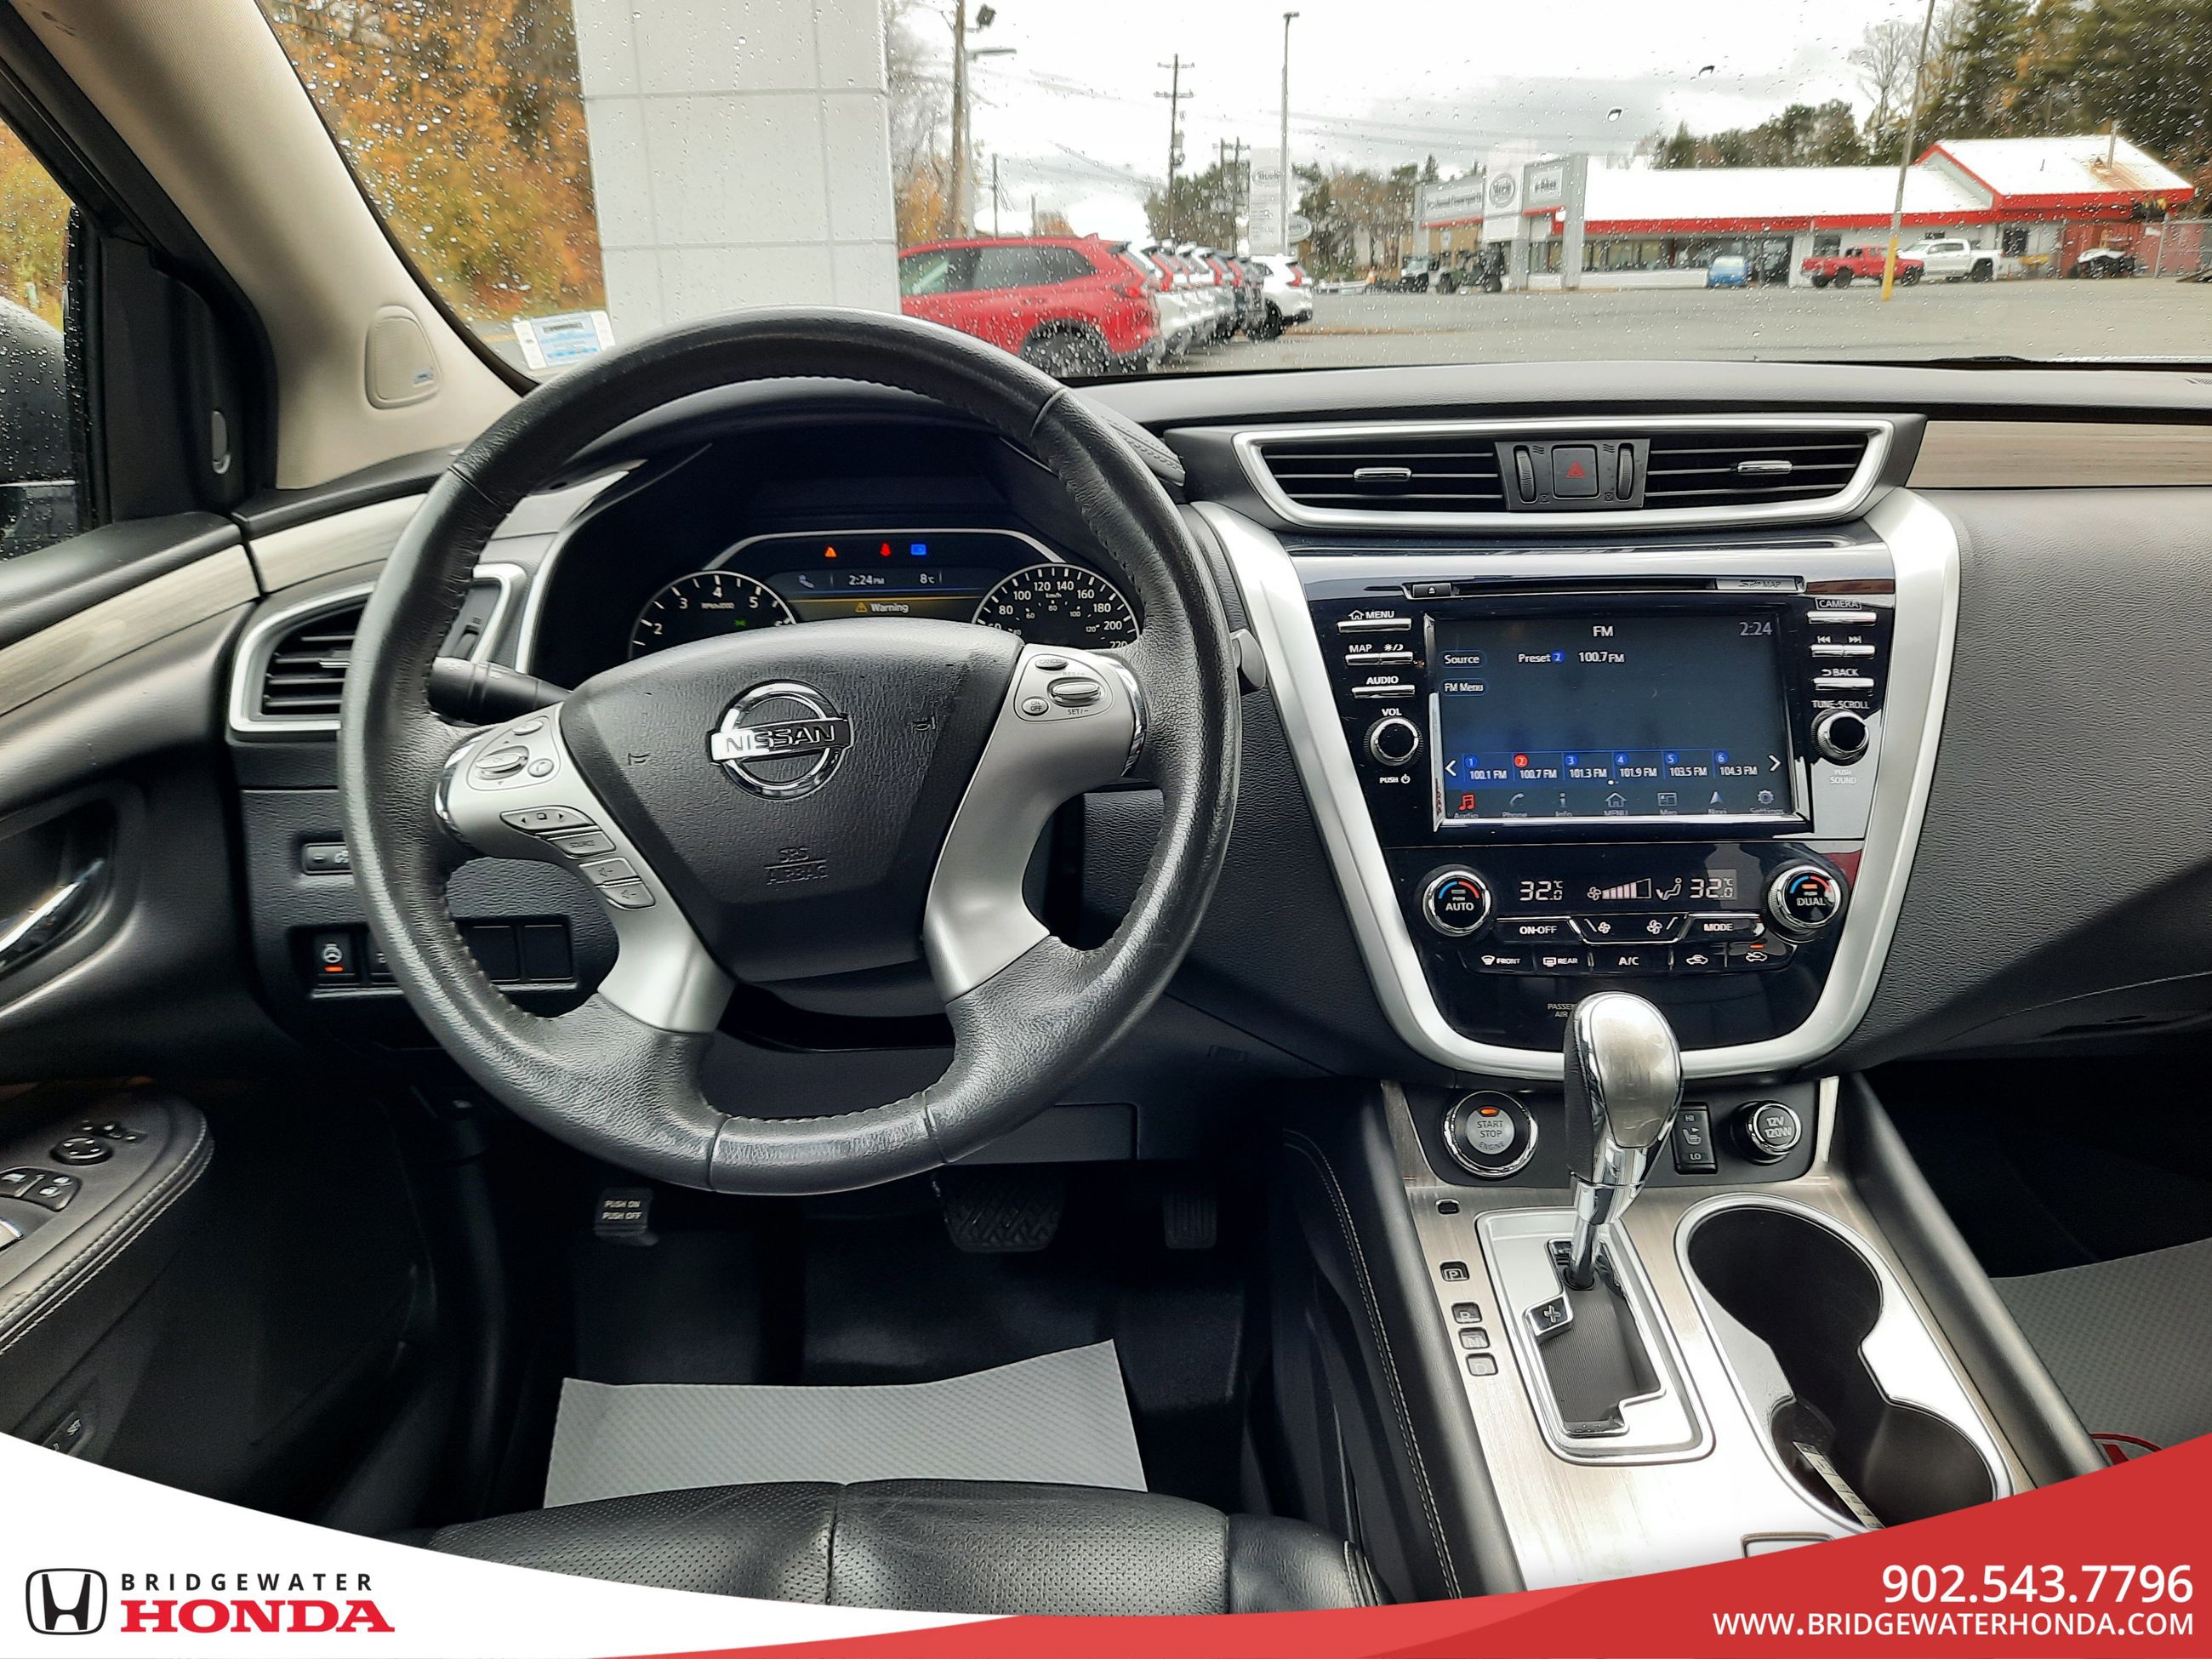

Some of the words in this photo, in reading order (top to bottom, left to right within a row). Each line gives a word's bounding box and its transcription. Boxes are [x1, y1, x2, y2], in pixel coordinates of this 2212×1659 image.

[1034, 582, 1051, 591] 120
[1057, 581, 1075, 591] 140
[712, 586, 722, 598] 4
[1013, 590, 1031, 601] 100
[1077, 590, 1094, 599] 160
[679, 598, 688, 609] 3
[749, 596, 758, 608] 5
[1818, 599, 1859, 608] CAMERA
[870, 603, 909, 613] Warning
[999, 605, 1013, 615] 80
[1093, 603, 1111, 613] 180
[1365, 611, 1395, 619] MENU
[652, 623, 663, 635] 2
[1103, 620, 1122, 630] 200
[1739, 622, 1773, 636] 2:24
[1593, 625, 1614, 637] FM
[1348, 644, 1372, 653] MAP
[1444, 655, 1480, 664] Source
[1518, 653, 1552, 663] Preset
[1833, 669, 1859, 677] BACK
[1366, 676, 1400, 685] AUDIO
[1444, 683, 1458, 693] FM
[1459, 682, 1484, 693] Menu
[1382, 708, 1402, 716] VOL
[726, 725, 835, 753] NISSAN
[1469, 770, 1491, 780] 100.1
[1493, 770, 1508, 779] FM
[1519, 770, 1541, 779] 100.7
[1543, 769, 1557, 778] FM
[1570, 769, 1592, 778] 101.3
[1593, 769, 1607, 778] FM
[1620, 768, 1642, 778] 101.9
[1644, 767, 1657, 777] FM
[1670, 767, 1691, 777] 103.5
[1694, 767, 1707, 776] FM
[1719, 767, 1742, 776] 104.3
[1744, 767, 1759, 775] FM
[1830, 776, 1856, 784] SOUND
[1445, 902, 1474, 911] AUTO
[1797, 898, 1827, 907] DUAL
[1704, 923, 1734, 932] MODE
[1619, 956, 1639, 966] A/C
[1477, 1120, 1503, 1129] START
[1766, 1116, 1784, 1126] 12V
[1480, 1130, 1502, 1138] STOP
[1764, 1127, 1792, 1138] 120W
[1479, 1141, 1505, 1150] ENGINE
[605, 1200, 627, 1208] PUSH
[601, 1211, 625, 1220] PUSH
[625, 1211, 642, 1220] OFF
